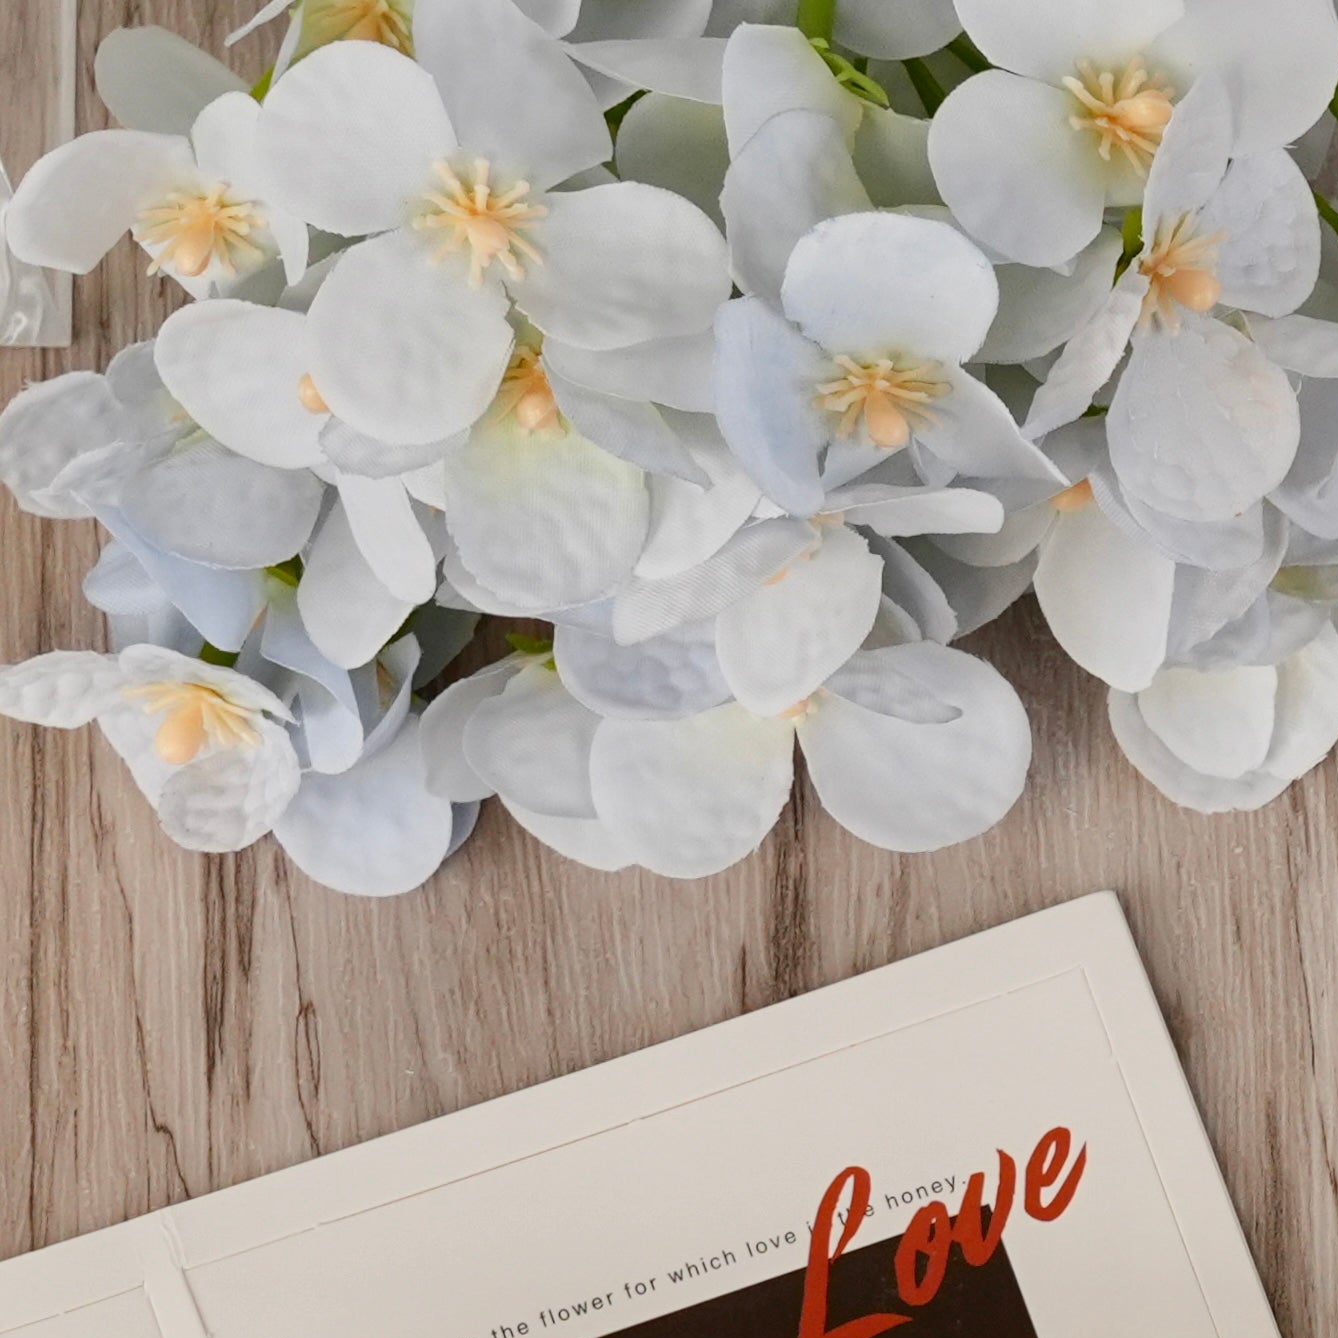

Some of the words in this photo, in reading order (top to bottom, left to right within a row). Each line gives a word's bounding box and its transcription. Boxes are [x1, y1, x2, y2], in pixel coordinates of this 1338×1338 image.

[539, 1292, 614, 1327] flower
[625, 1277, 657, 1299] for
[668, 1249, 737, 1284] which
[746, 1231, 797, 1257] love
[885, 1174, 966, 1210] honey.
